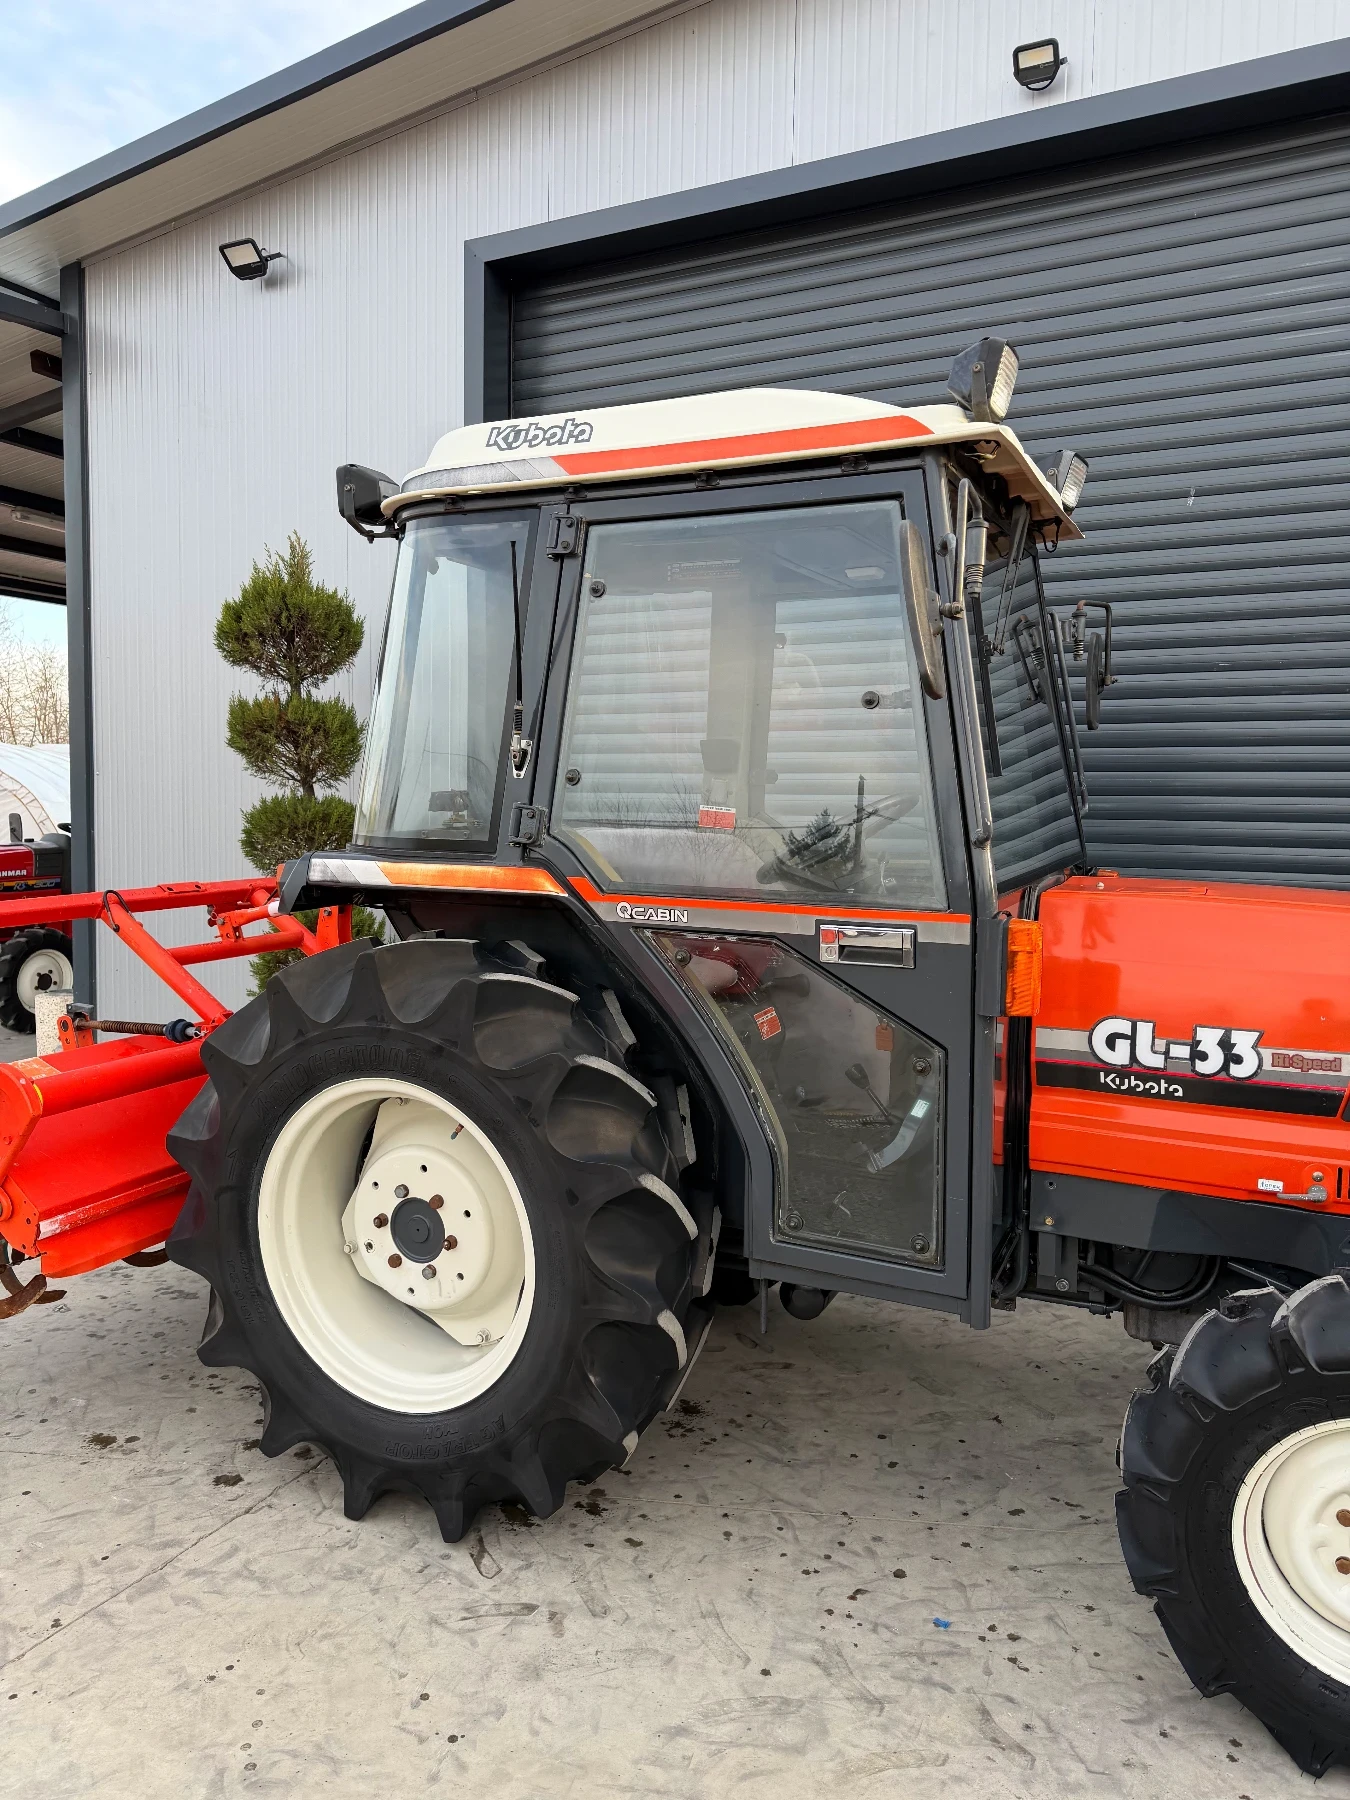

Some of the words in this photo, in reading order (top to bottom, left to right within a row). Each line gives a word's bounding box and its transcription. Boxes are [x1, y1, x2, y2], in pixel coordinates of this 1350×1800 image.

[486, 417, 594, 451] Kubota
[0, 869, 27, 877] NMAR
[1088, 1015, 1264, 1081] GL-33
[1100, 1071, 1184, 1098] Kubota
